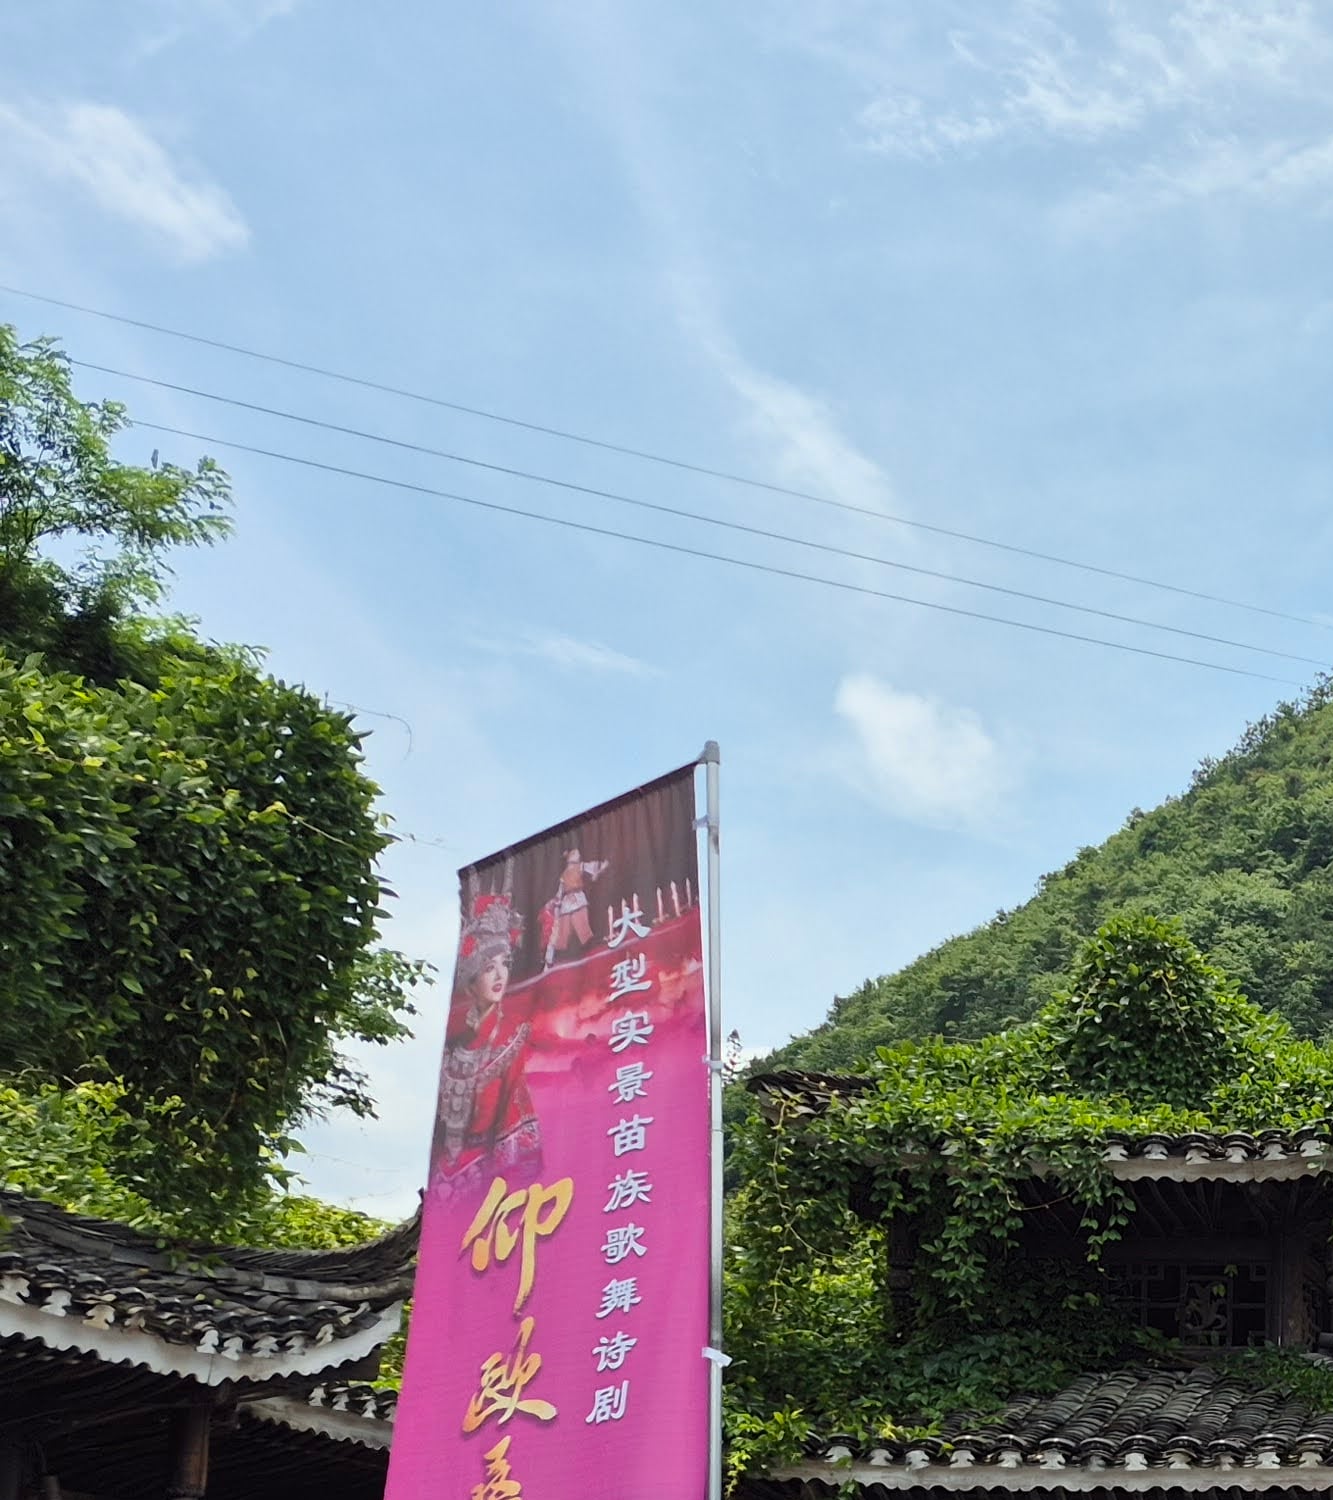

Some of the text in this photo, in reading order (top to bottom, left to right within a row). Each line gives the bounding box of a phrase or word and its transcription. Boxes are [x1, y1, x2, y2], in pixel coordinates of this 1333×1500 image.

[585, 907, 655, 1426] 大型实景苗族歌舞诗剧
